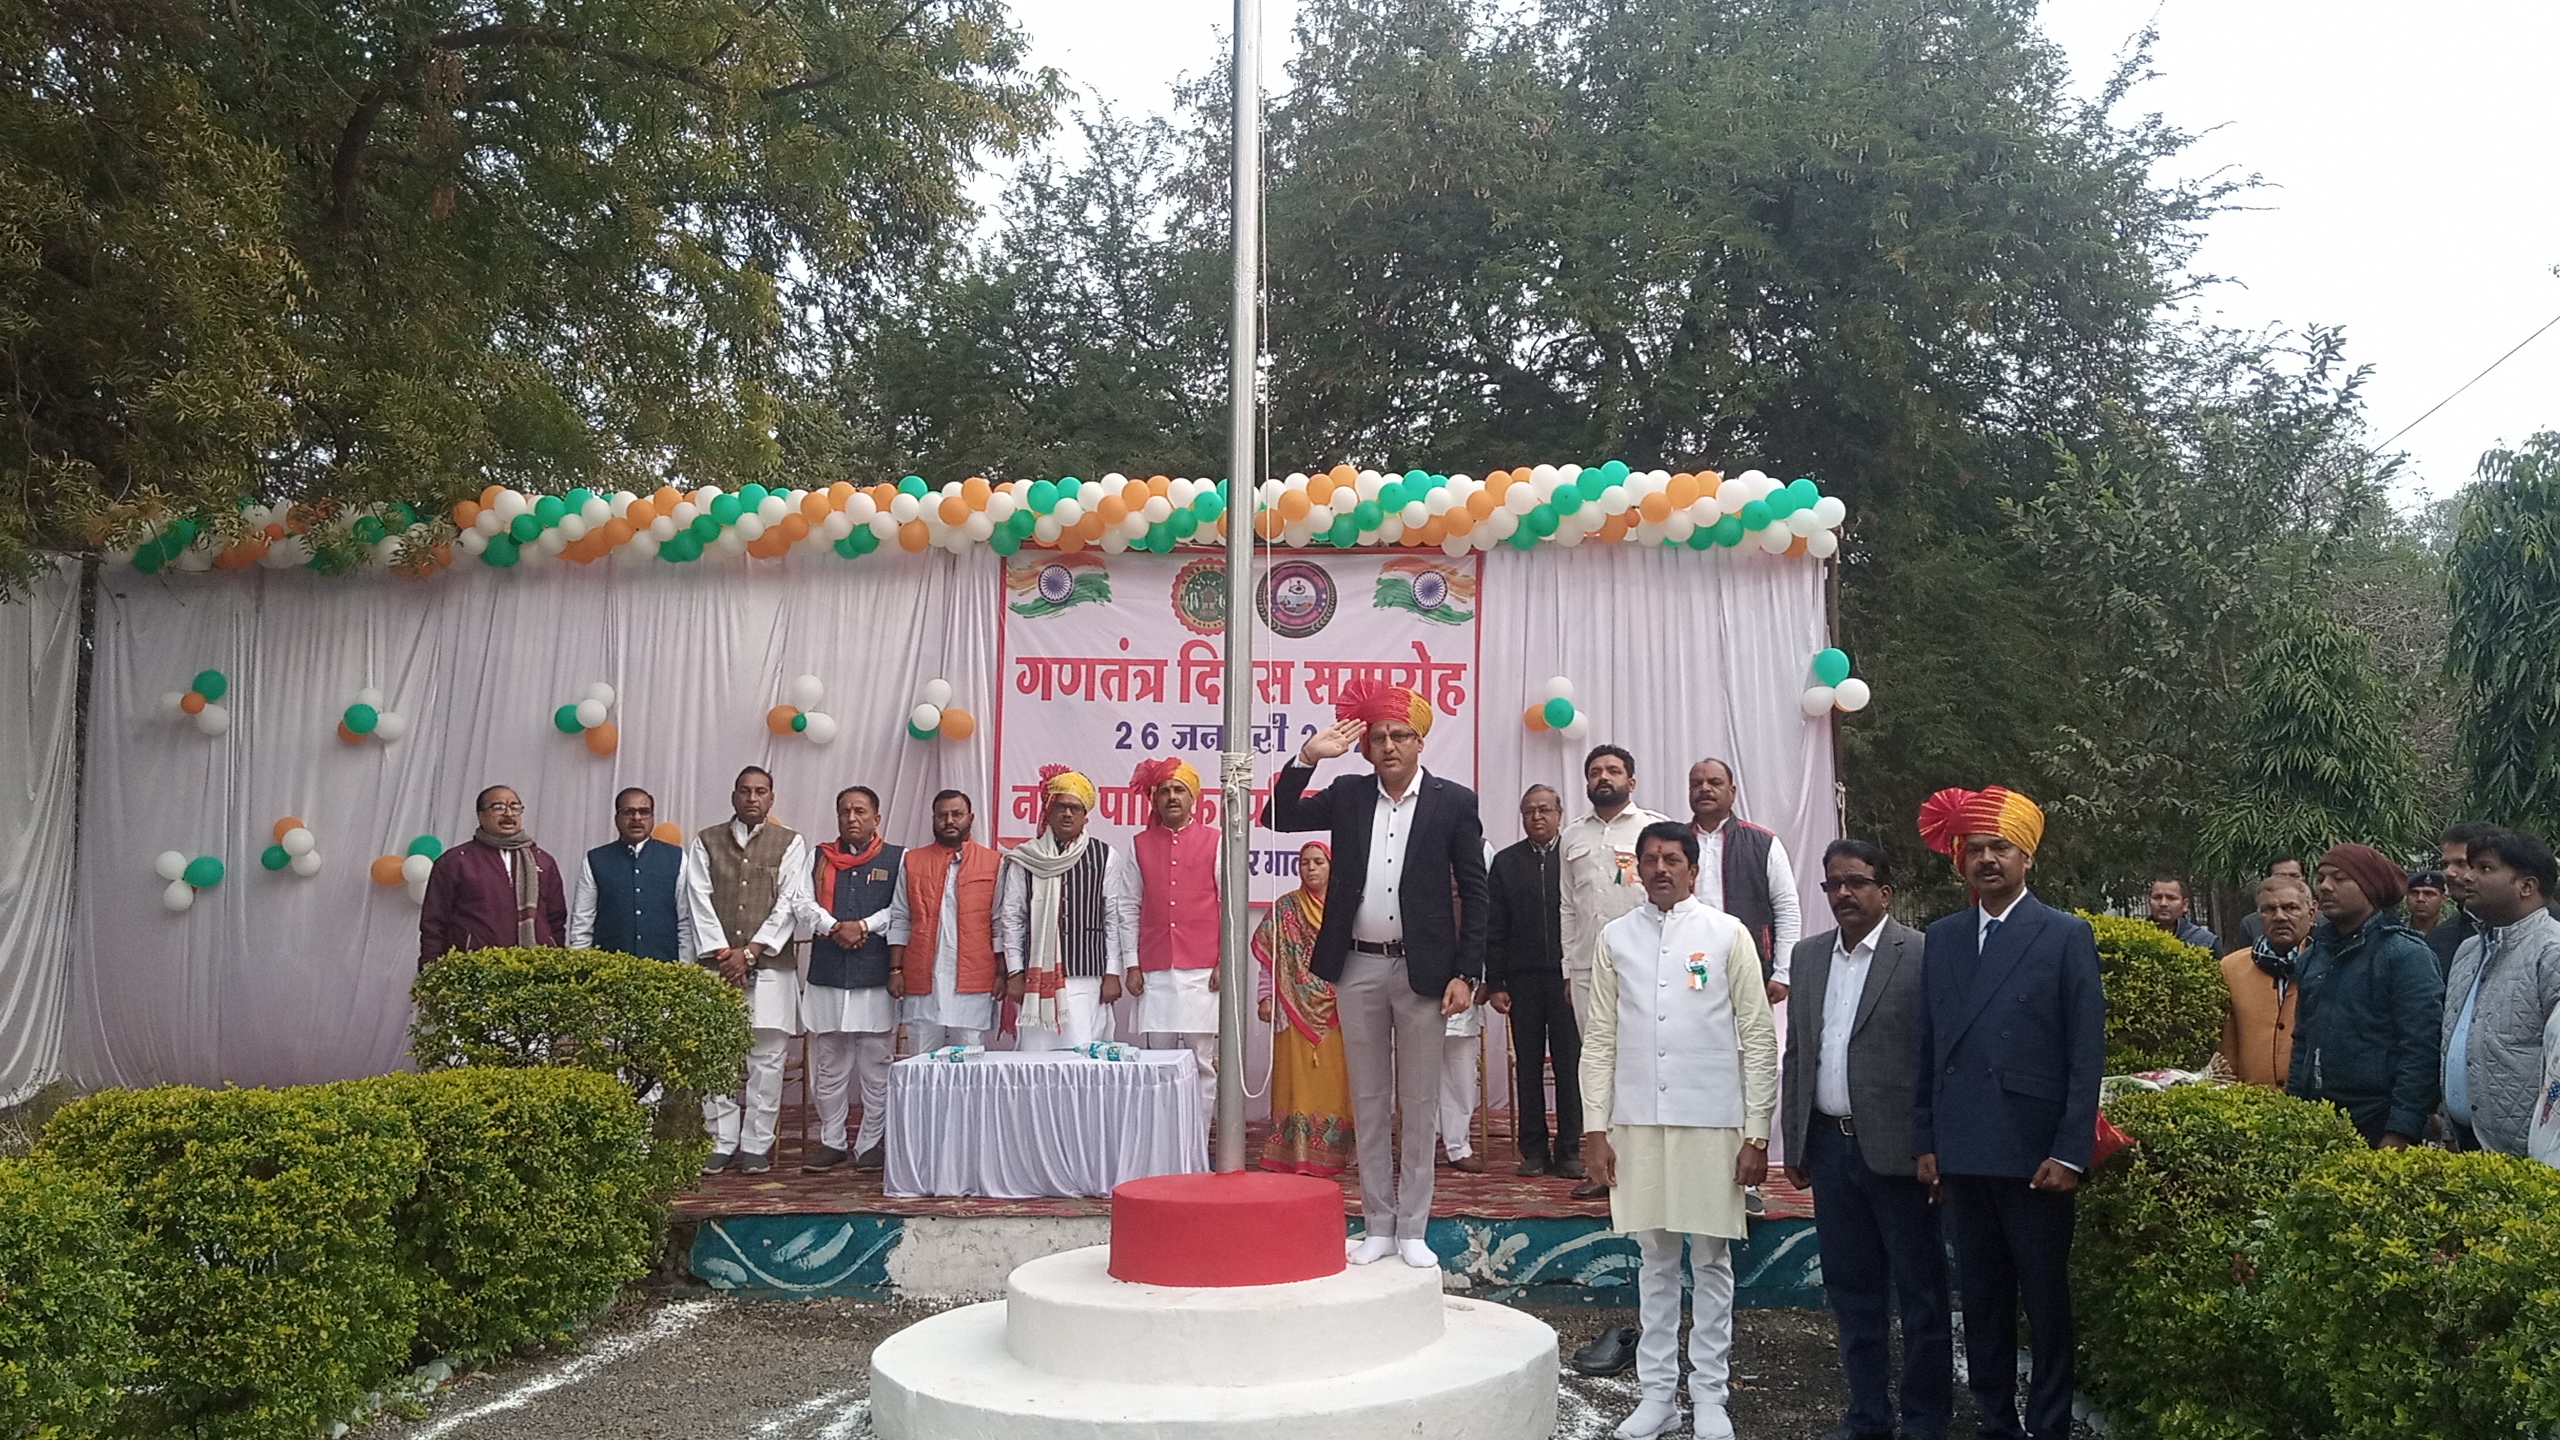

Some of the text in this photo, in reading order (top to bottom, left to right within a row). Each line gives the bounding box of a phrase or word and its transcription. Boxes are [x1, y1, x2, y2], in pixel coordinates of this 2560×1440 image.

[1015, 637, 1168, 702] गणतंत्र
[1177, 639, 1295, 705] दिस
[1115, 721, 1159, 750] 26
[1171, 712, 1289, 752] जनरी
